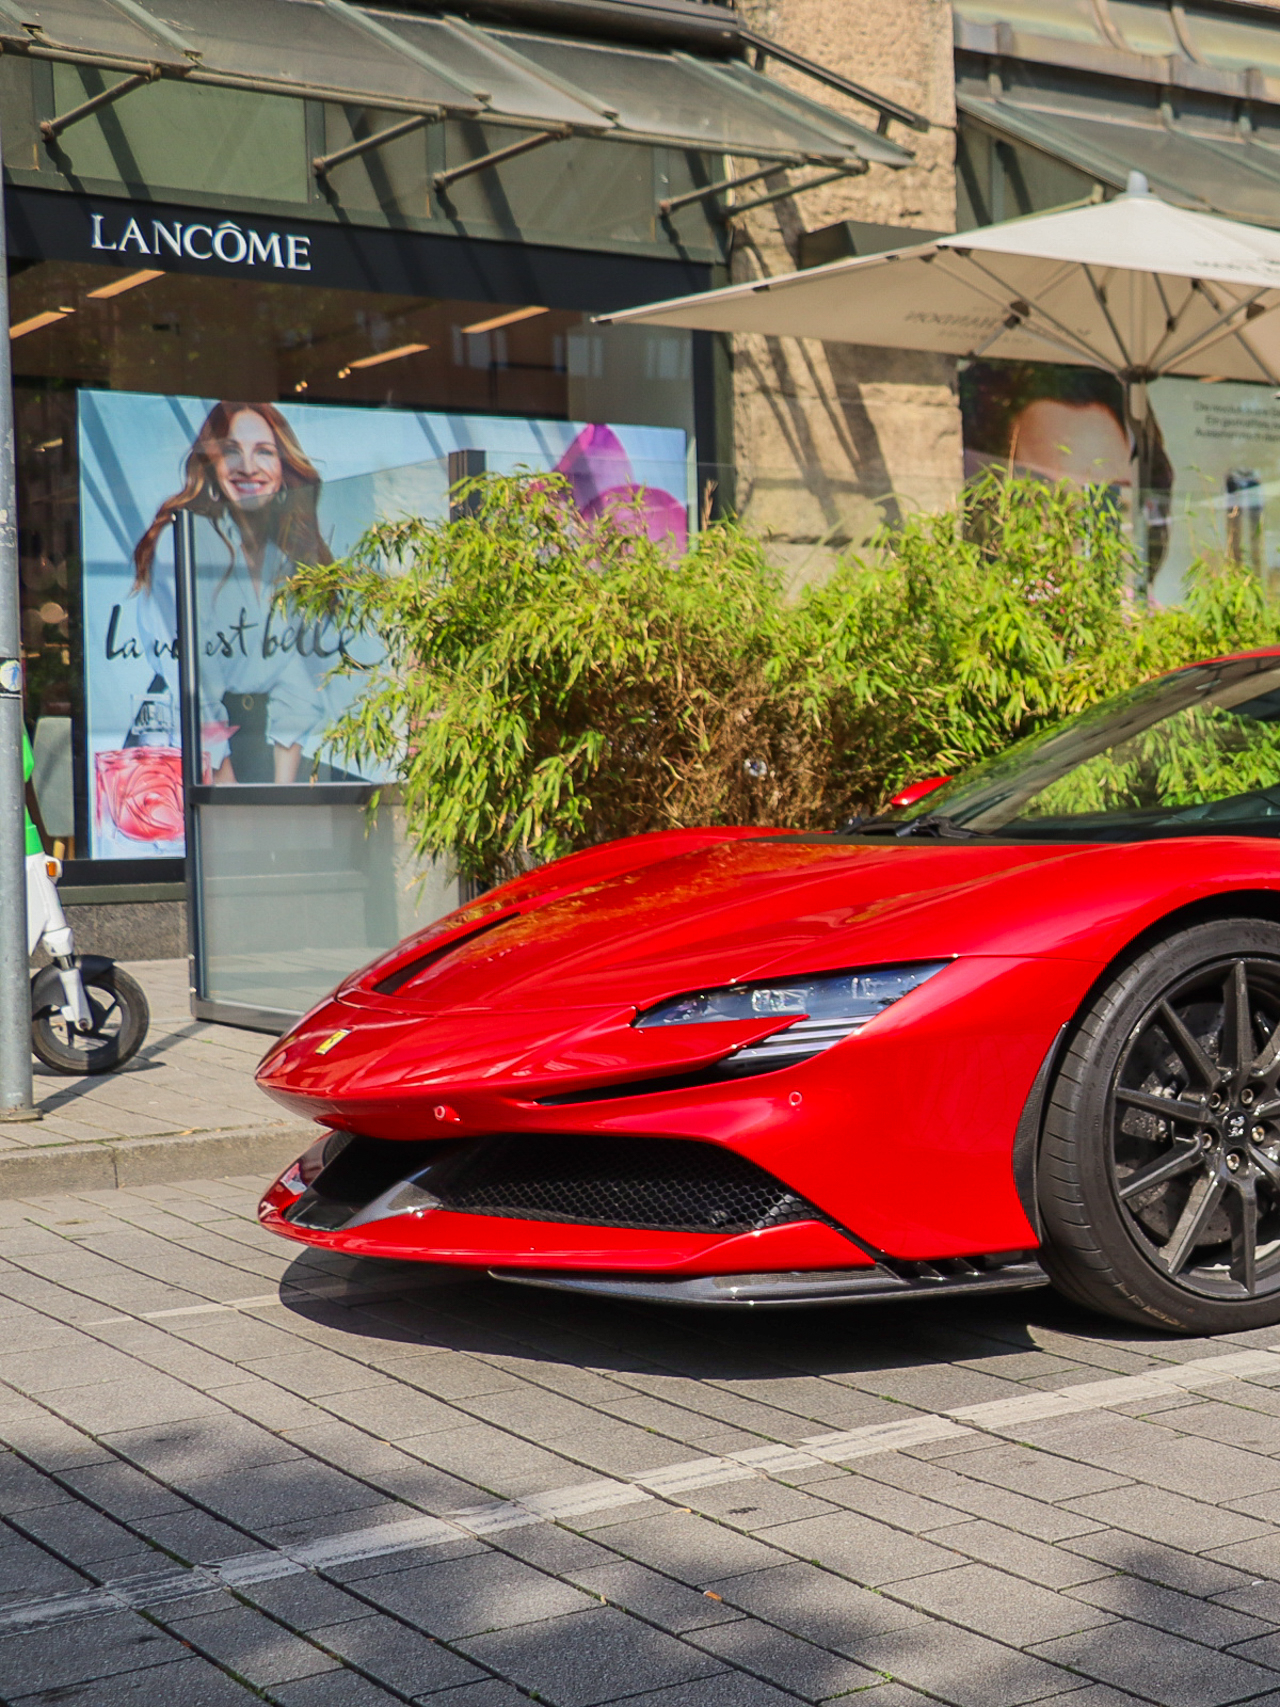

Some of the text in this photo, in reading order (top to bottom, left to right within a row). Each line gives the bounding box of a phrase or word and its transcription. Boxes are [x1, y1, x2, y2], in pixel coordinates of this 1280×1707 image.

[91, 213, 312, 271] LANCÔME
[106, 604, 144, 660] La
[205, 607, 258, 658] est
